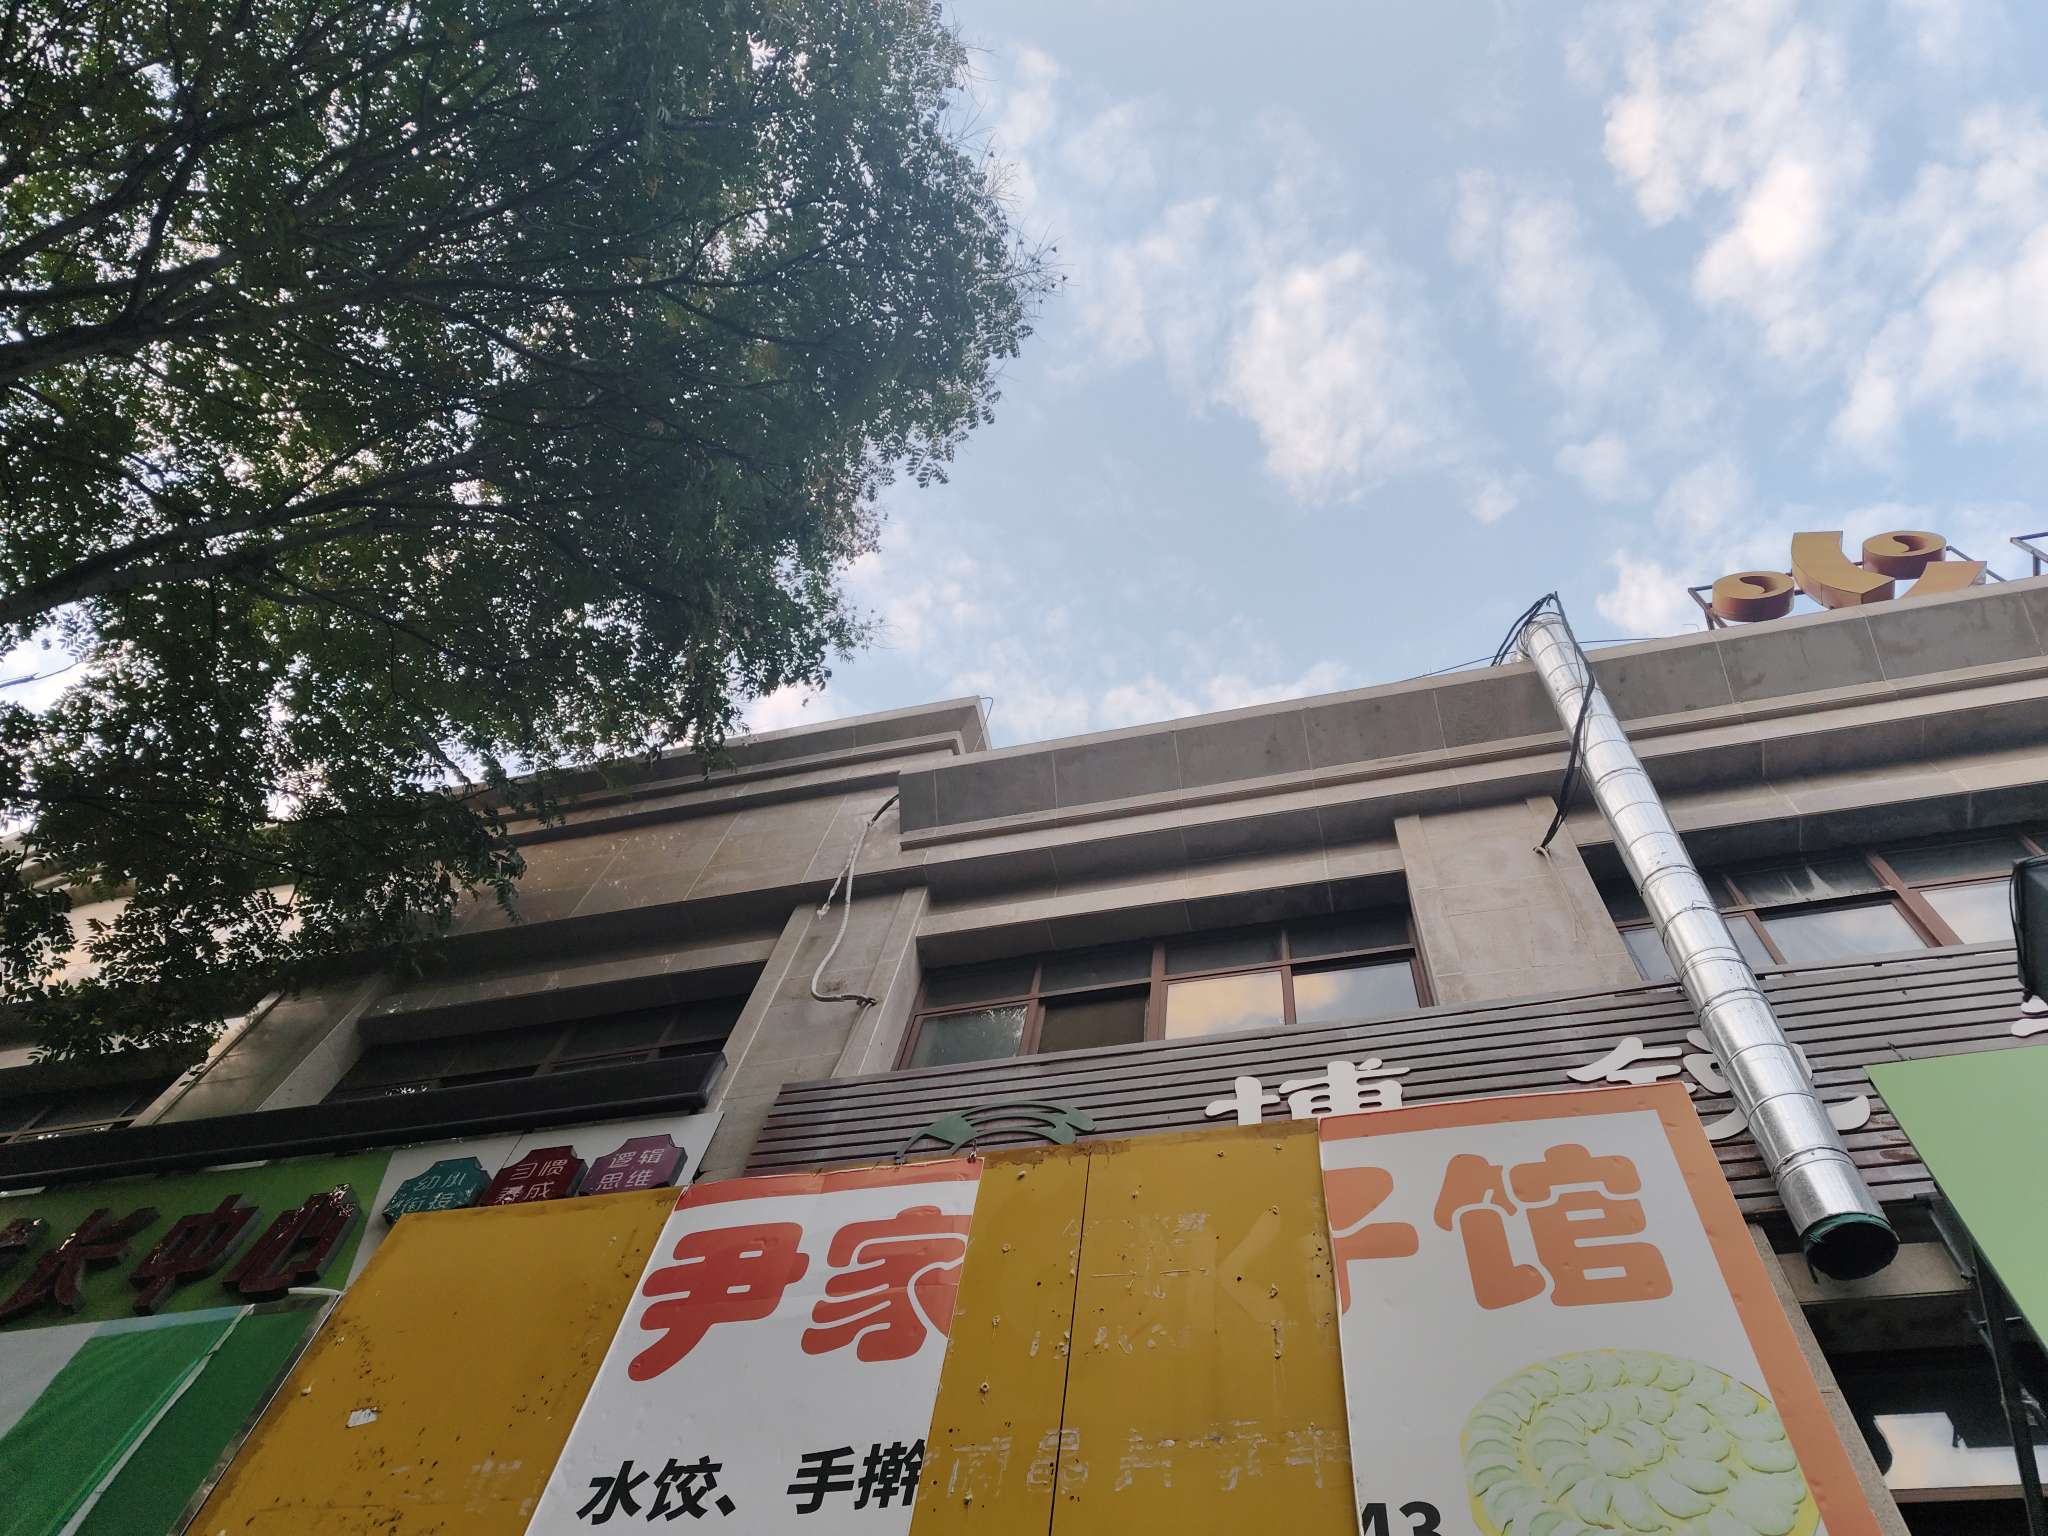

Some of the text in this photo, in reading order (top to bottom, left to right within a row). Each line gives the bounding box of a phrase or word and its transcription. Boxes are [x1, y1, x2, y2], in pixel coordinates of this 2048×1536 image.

[607, 1147, 666, 1169] 逻辑
[510, 1159, 568, 1181] 习惯
[596, 1168, 655, 1190] 思维
[628, 1205, 973, 1381] 尹家
